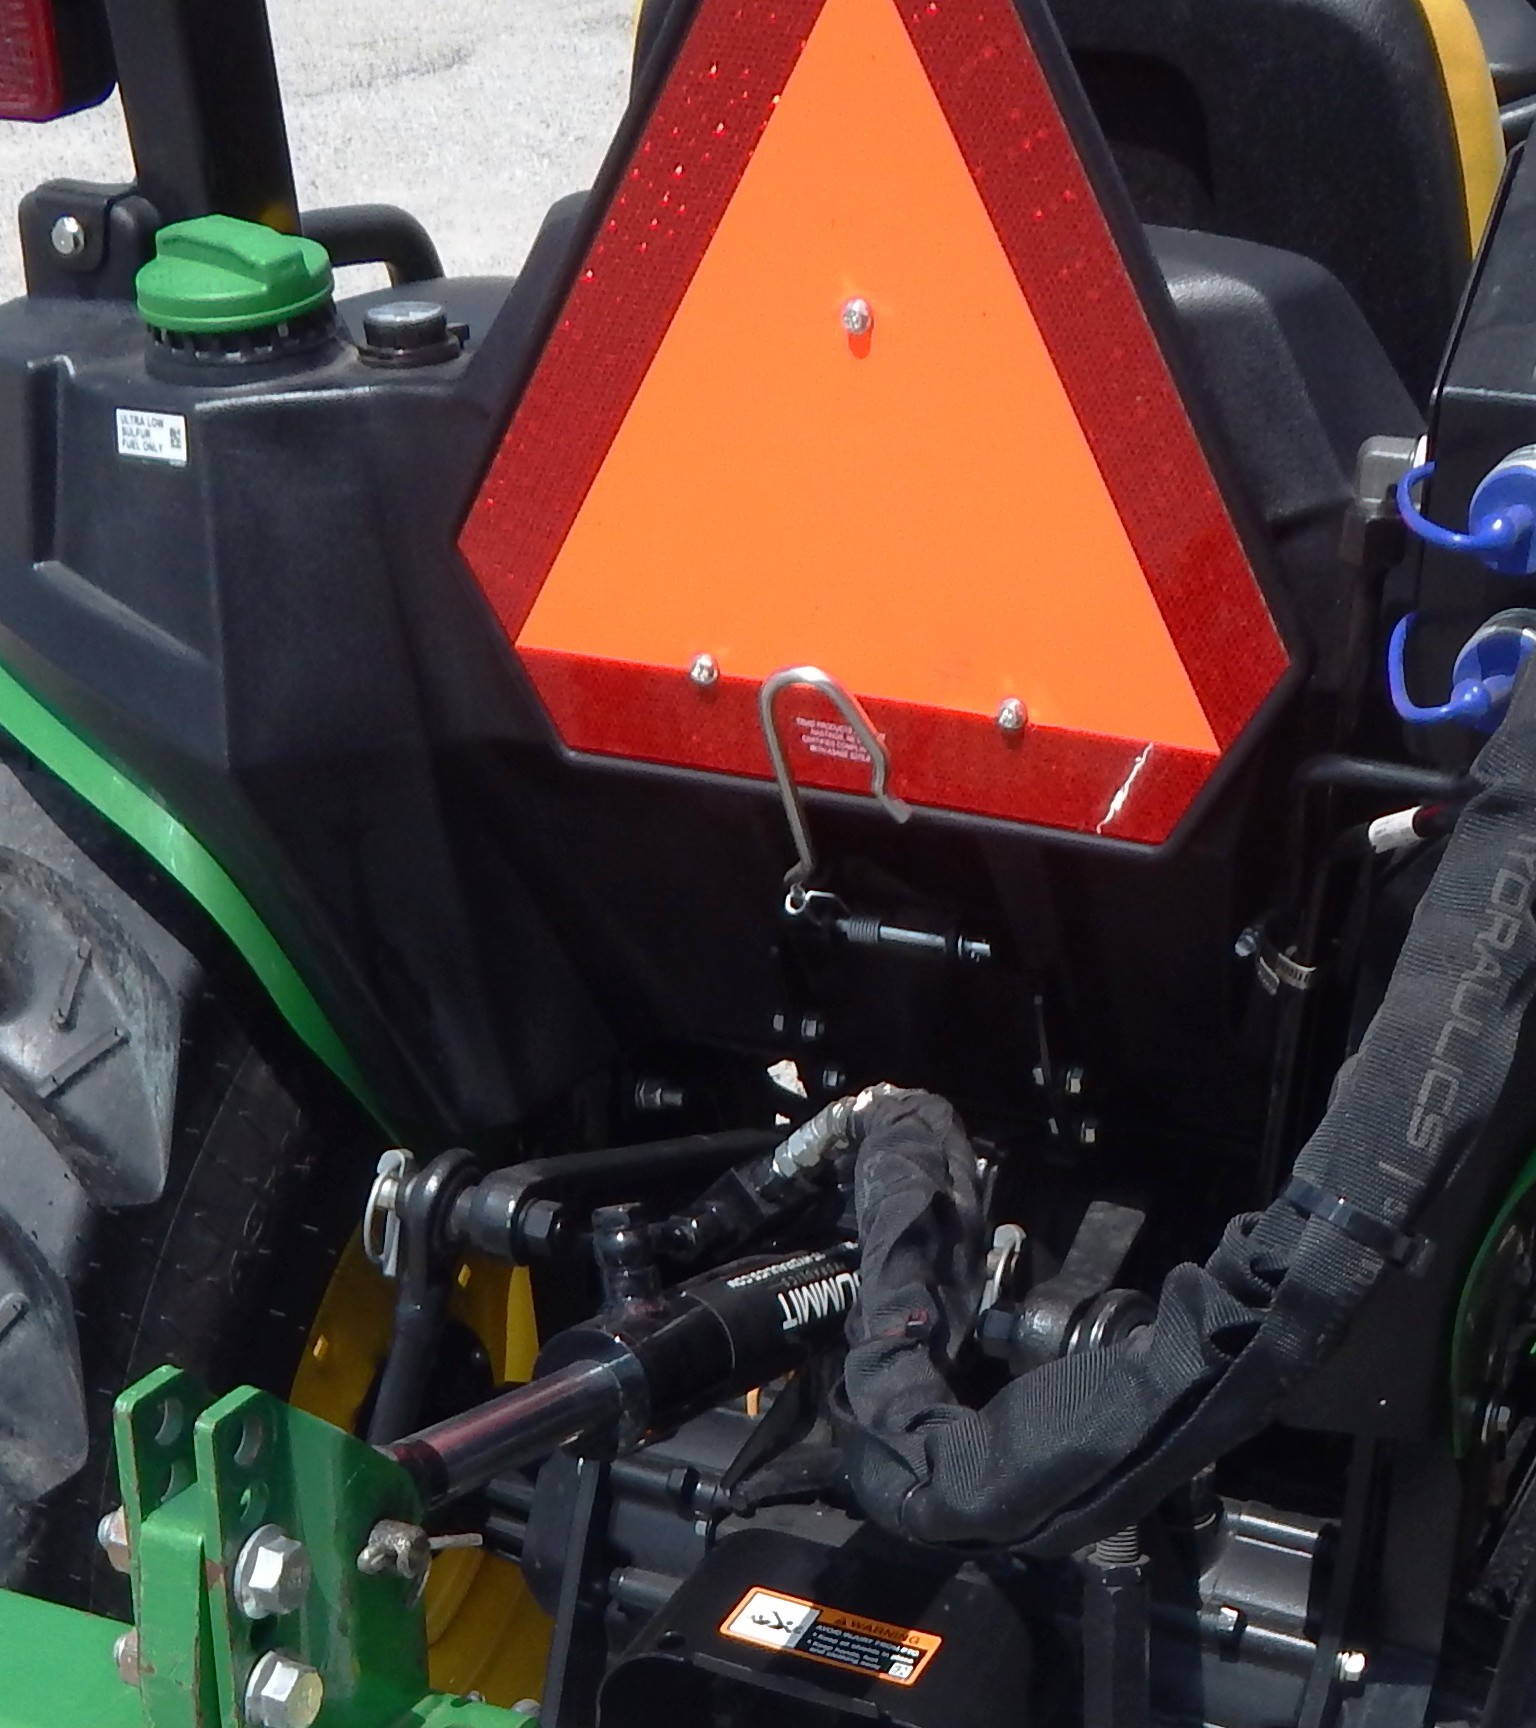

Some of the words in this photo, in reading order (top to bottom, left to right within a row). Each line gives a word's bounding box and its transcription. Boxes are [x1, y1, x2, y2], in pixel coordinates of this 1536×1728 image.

[120, 414, 145, 425] ULTRA
[146, 416, 164, 428] LOW
[121, 426, 151, 438] SULFUR
[122, 438, 141, 450] FUEL
[142, 441, 163, 452] ONLY
[777, 1271, 862, 1331] UMMIT
[850, 1620, 921, 1645] WARNING
